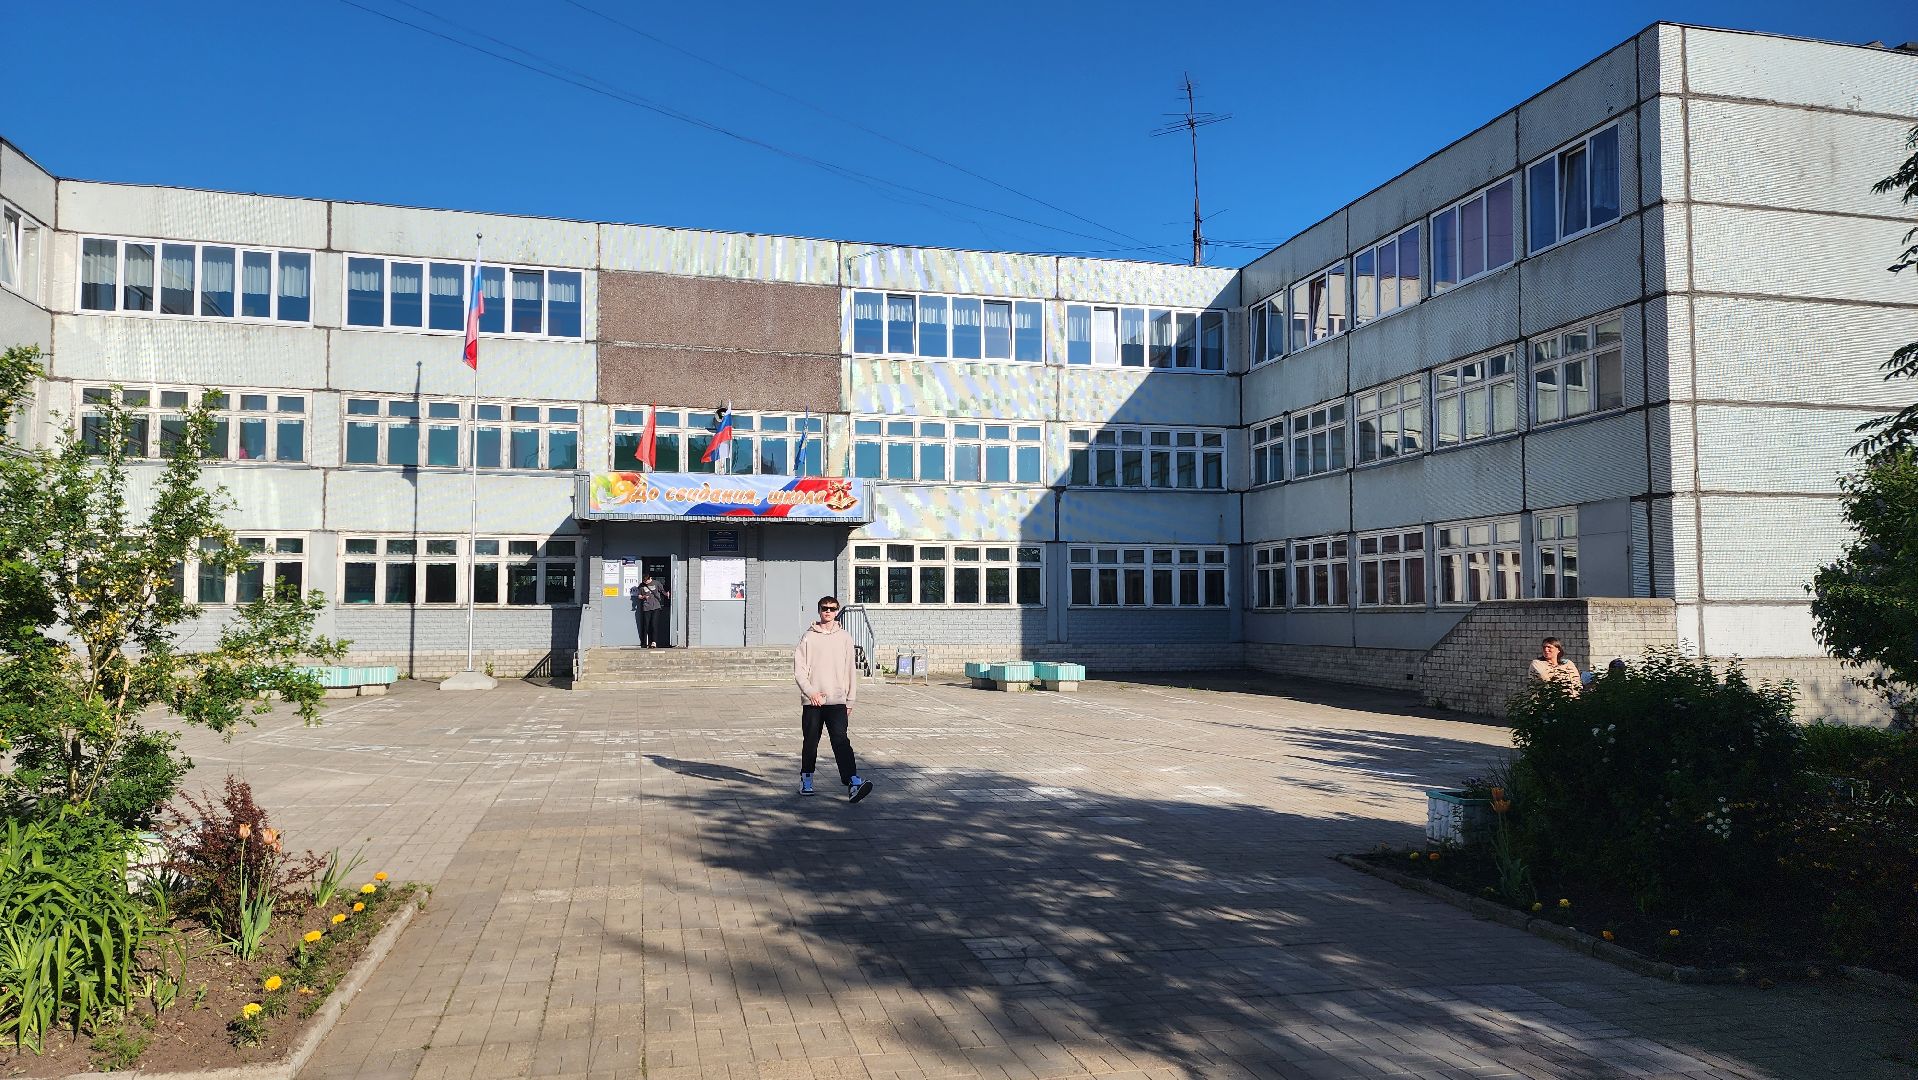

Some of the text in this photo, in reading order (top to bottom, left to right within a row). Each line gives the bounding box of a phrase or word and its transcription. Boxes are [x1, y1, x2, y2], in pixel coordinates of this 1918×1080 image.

[630, 482, 827, 506] До свидания, школа
